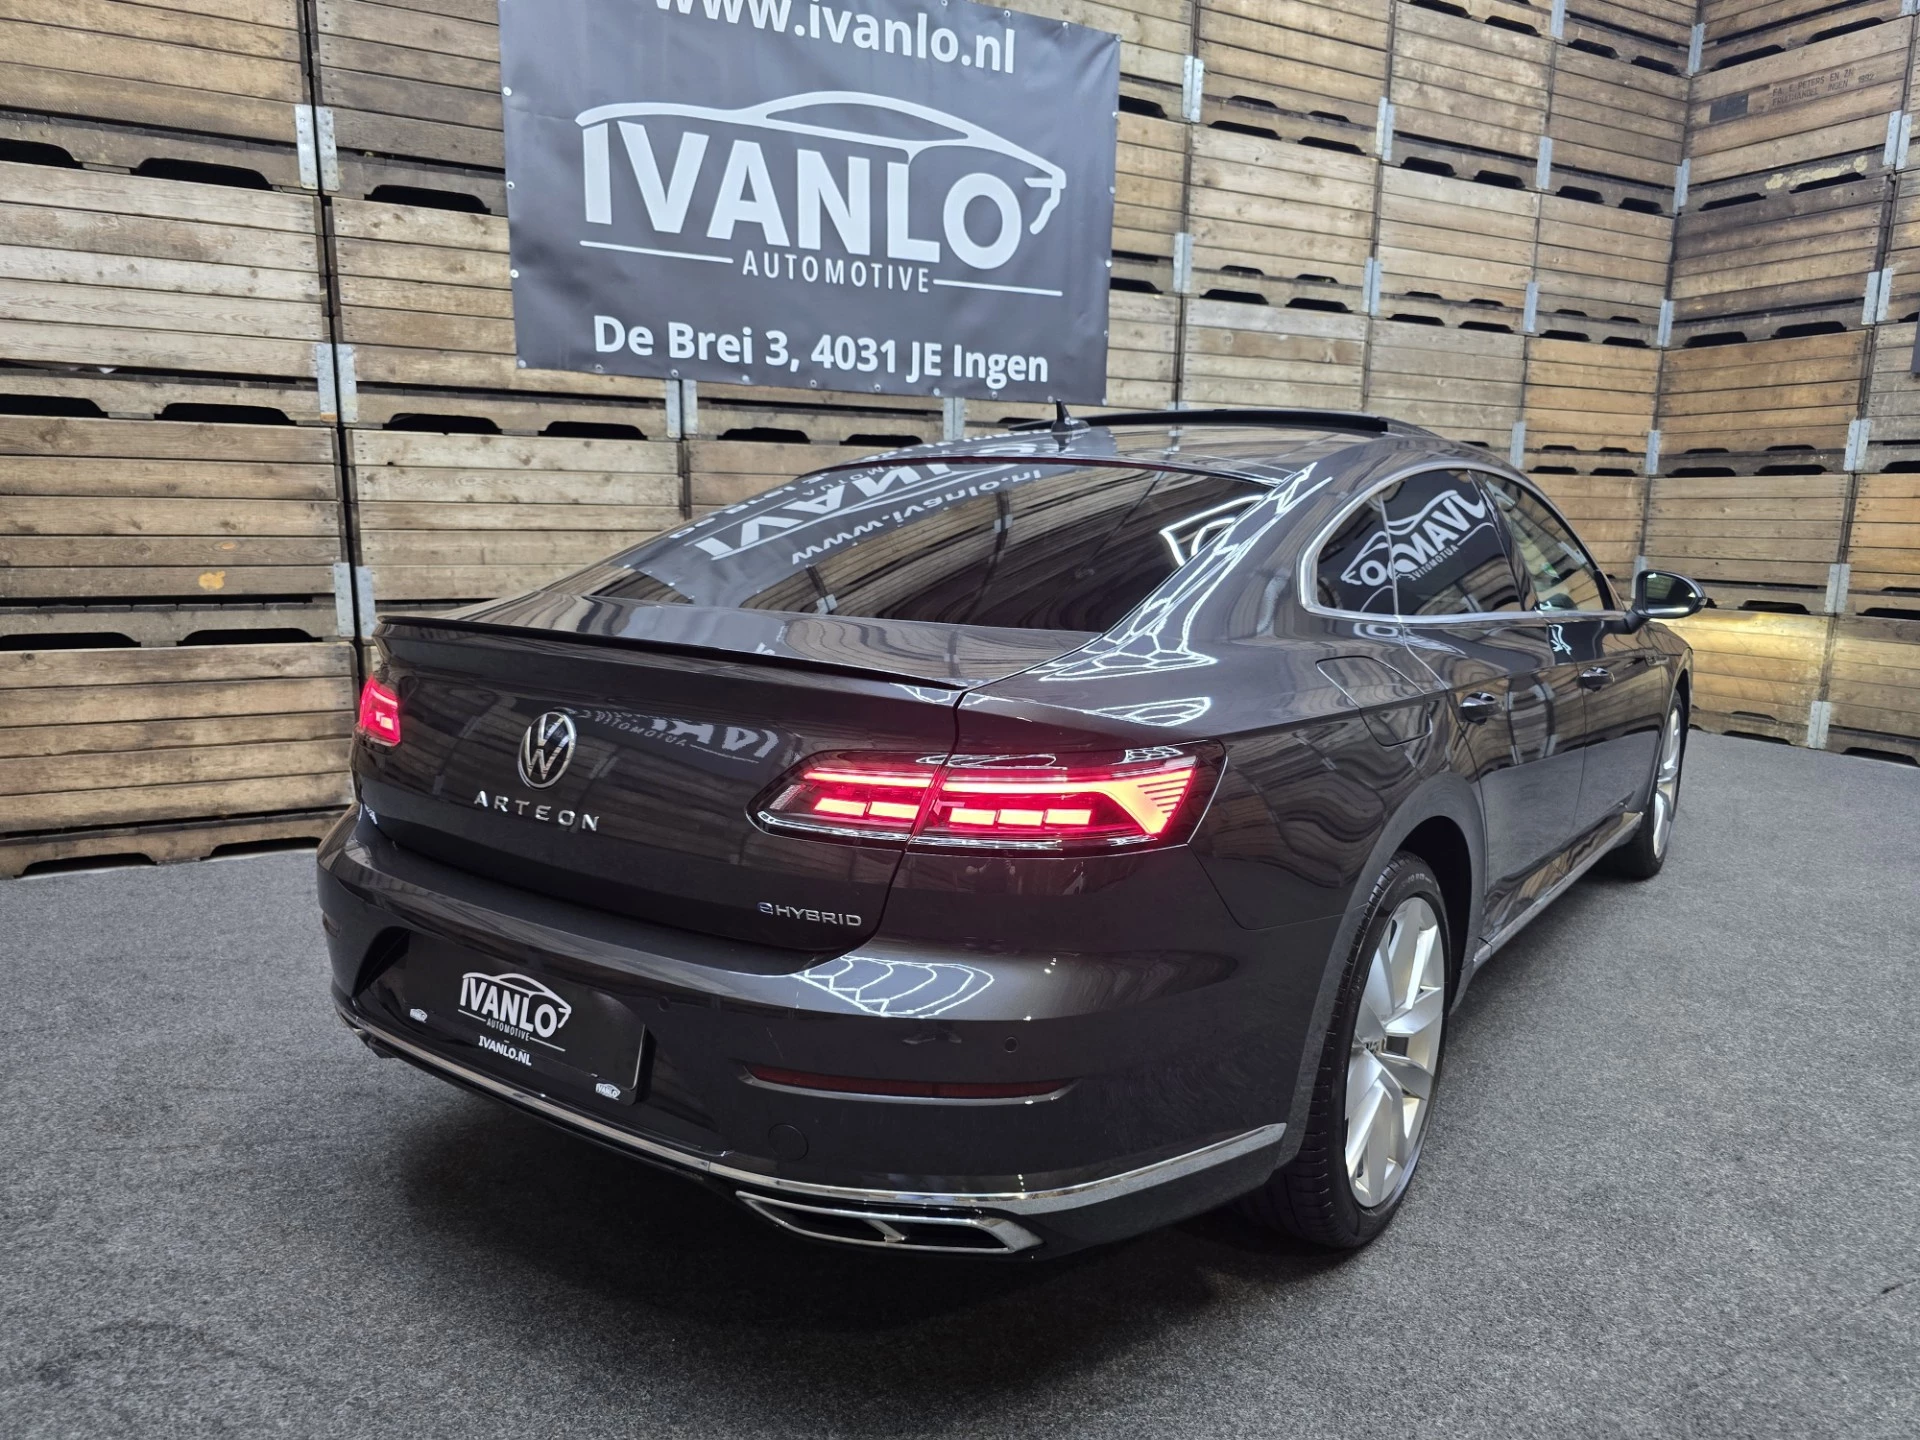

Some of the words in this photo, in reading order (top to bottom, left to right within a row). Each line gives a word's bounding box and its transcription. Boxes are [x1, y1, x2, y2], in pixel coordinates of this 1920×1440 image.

[1797, 76, 1825, 90] PETERS
[1829, 71, 1840, 81] EN
[583, 122, 1022, 270] IVANLO
[742, 250, 930, 294] AUTOMOTIVE
[594, 315, 654, 355] De
[668, 321, 752, 364] Brei
[765, 330, 799, 373] 3,
[810, 334, 896, 373] 4031
[906, 341, 942, 384] JE
[954, 344, 1048, 390] Ingen
[473, 790, 600, 832] ARTEON
[460, 977, 558, 1038] IVANLO
[478, 1035, 532, 1067] IVANLO.NL
[486, 1018, 531, 1042] AUTOMOTIVE
